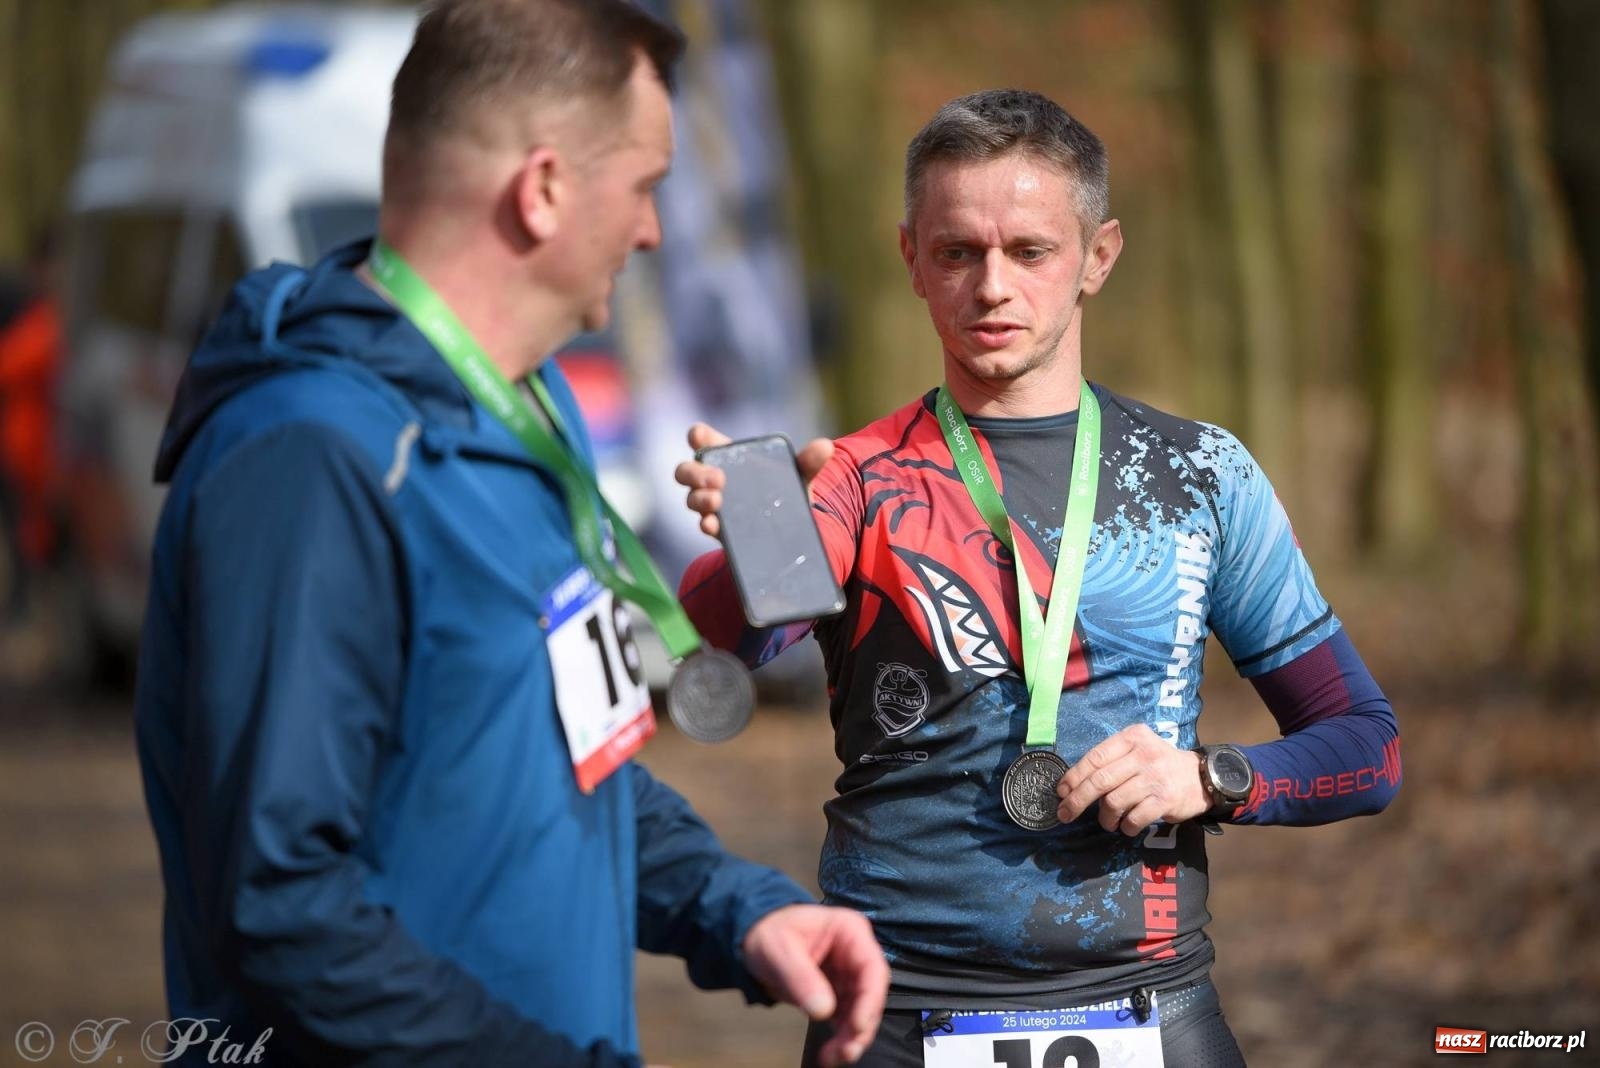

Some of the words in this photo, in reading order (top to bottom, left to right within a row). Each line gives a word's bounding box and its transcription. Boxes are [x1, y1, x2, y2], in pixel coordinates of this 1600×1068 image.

[945, 405, 968, 453] Racibórz
[967, 459, 985, 486] OSiR
[879, 693, 923, 706] AKTYWNI
[1002, 1016, 1017, 1028] 25
[1020, 1015, 1057, 1030] lutego
[1059, 1014, 1087, 1025] 2024
